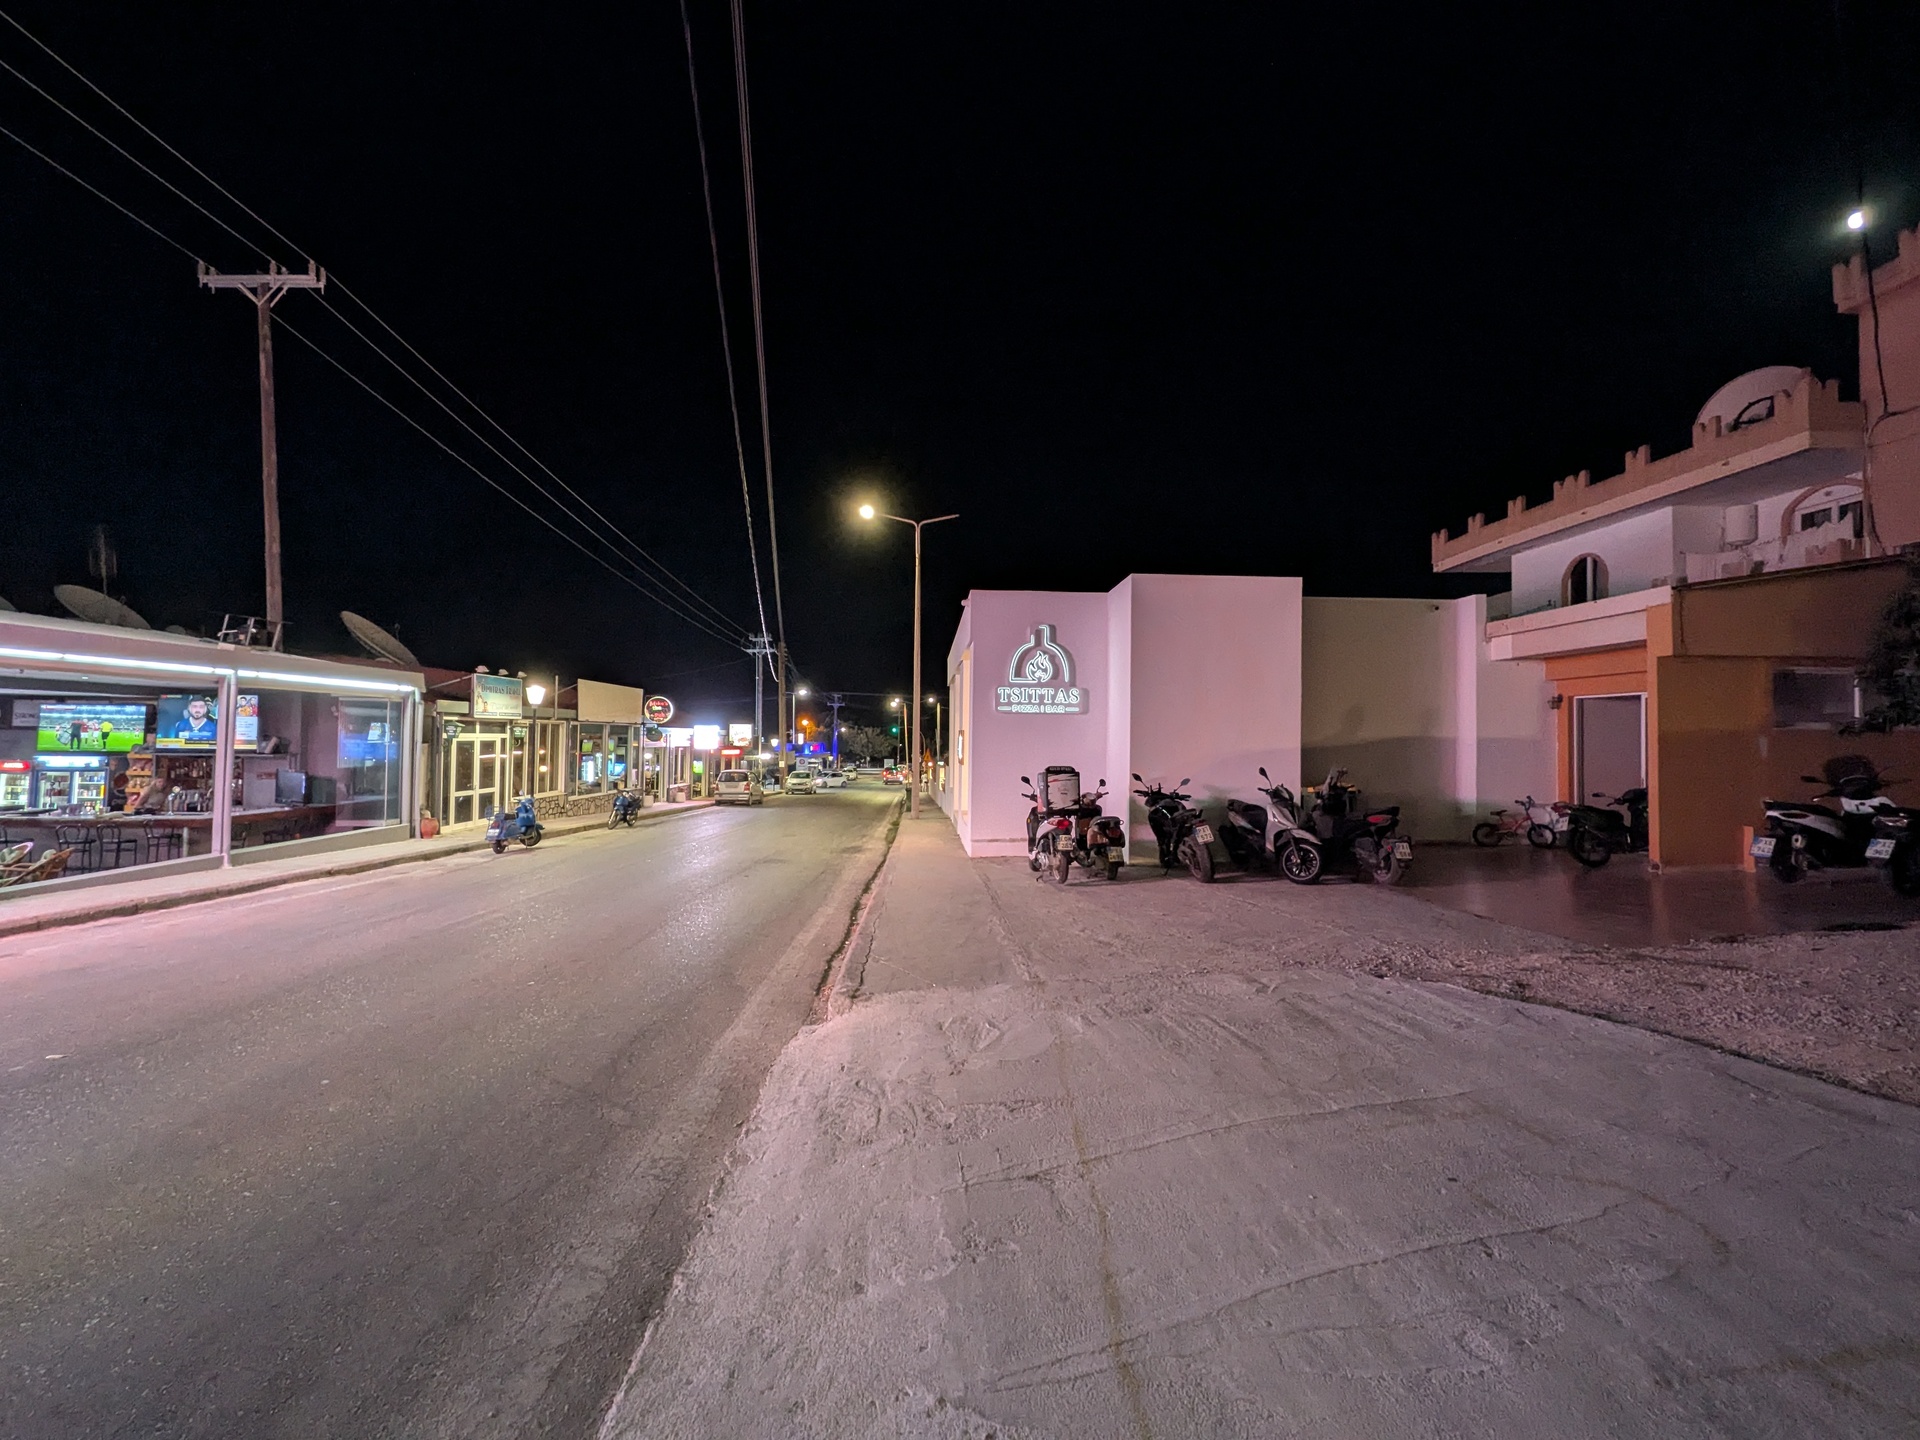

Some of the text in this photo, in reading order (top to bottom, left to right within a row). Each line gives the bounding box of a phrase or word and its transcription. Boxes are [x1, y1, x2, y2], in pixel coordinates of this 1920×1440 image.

[998, 687, 1080, 704] TSITTAS
[1012, 704, 1065, 713] PIZZA BAR
